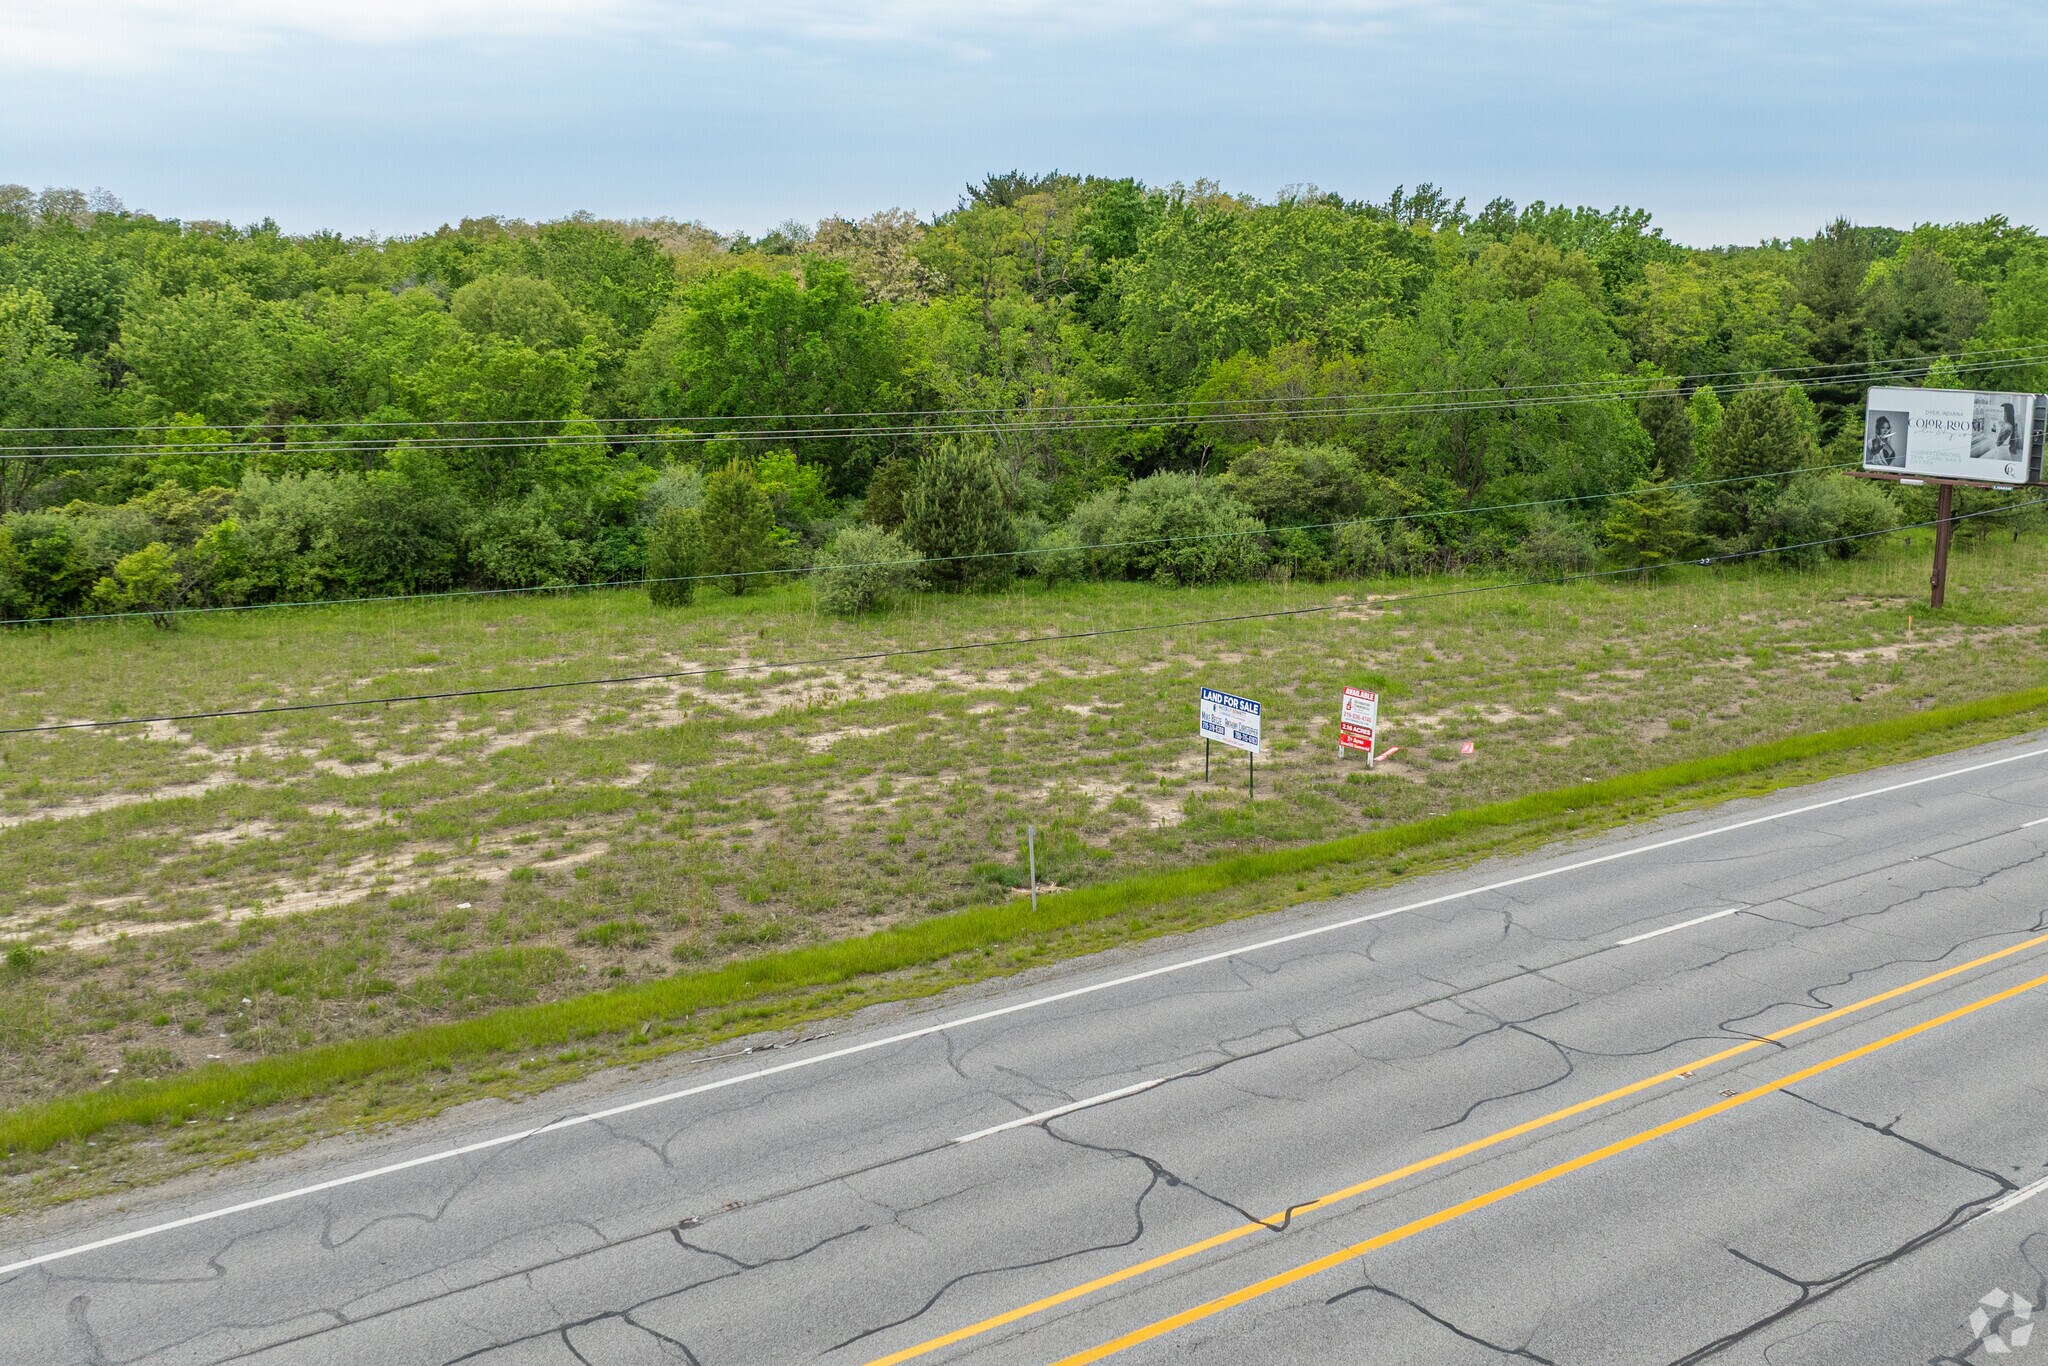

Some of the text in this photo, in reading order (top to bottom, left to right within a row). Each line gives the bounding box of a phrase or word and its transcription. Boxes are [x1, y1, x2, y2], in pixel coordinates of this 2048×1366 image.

[1345, 688, 1374, 701] AVAILABLE
[1203, 690, 1259, 714] LAND FOR SALE
[1353, 726, 1371, 736] ACRES
